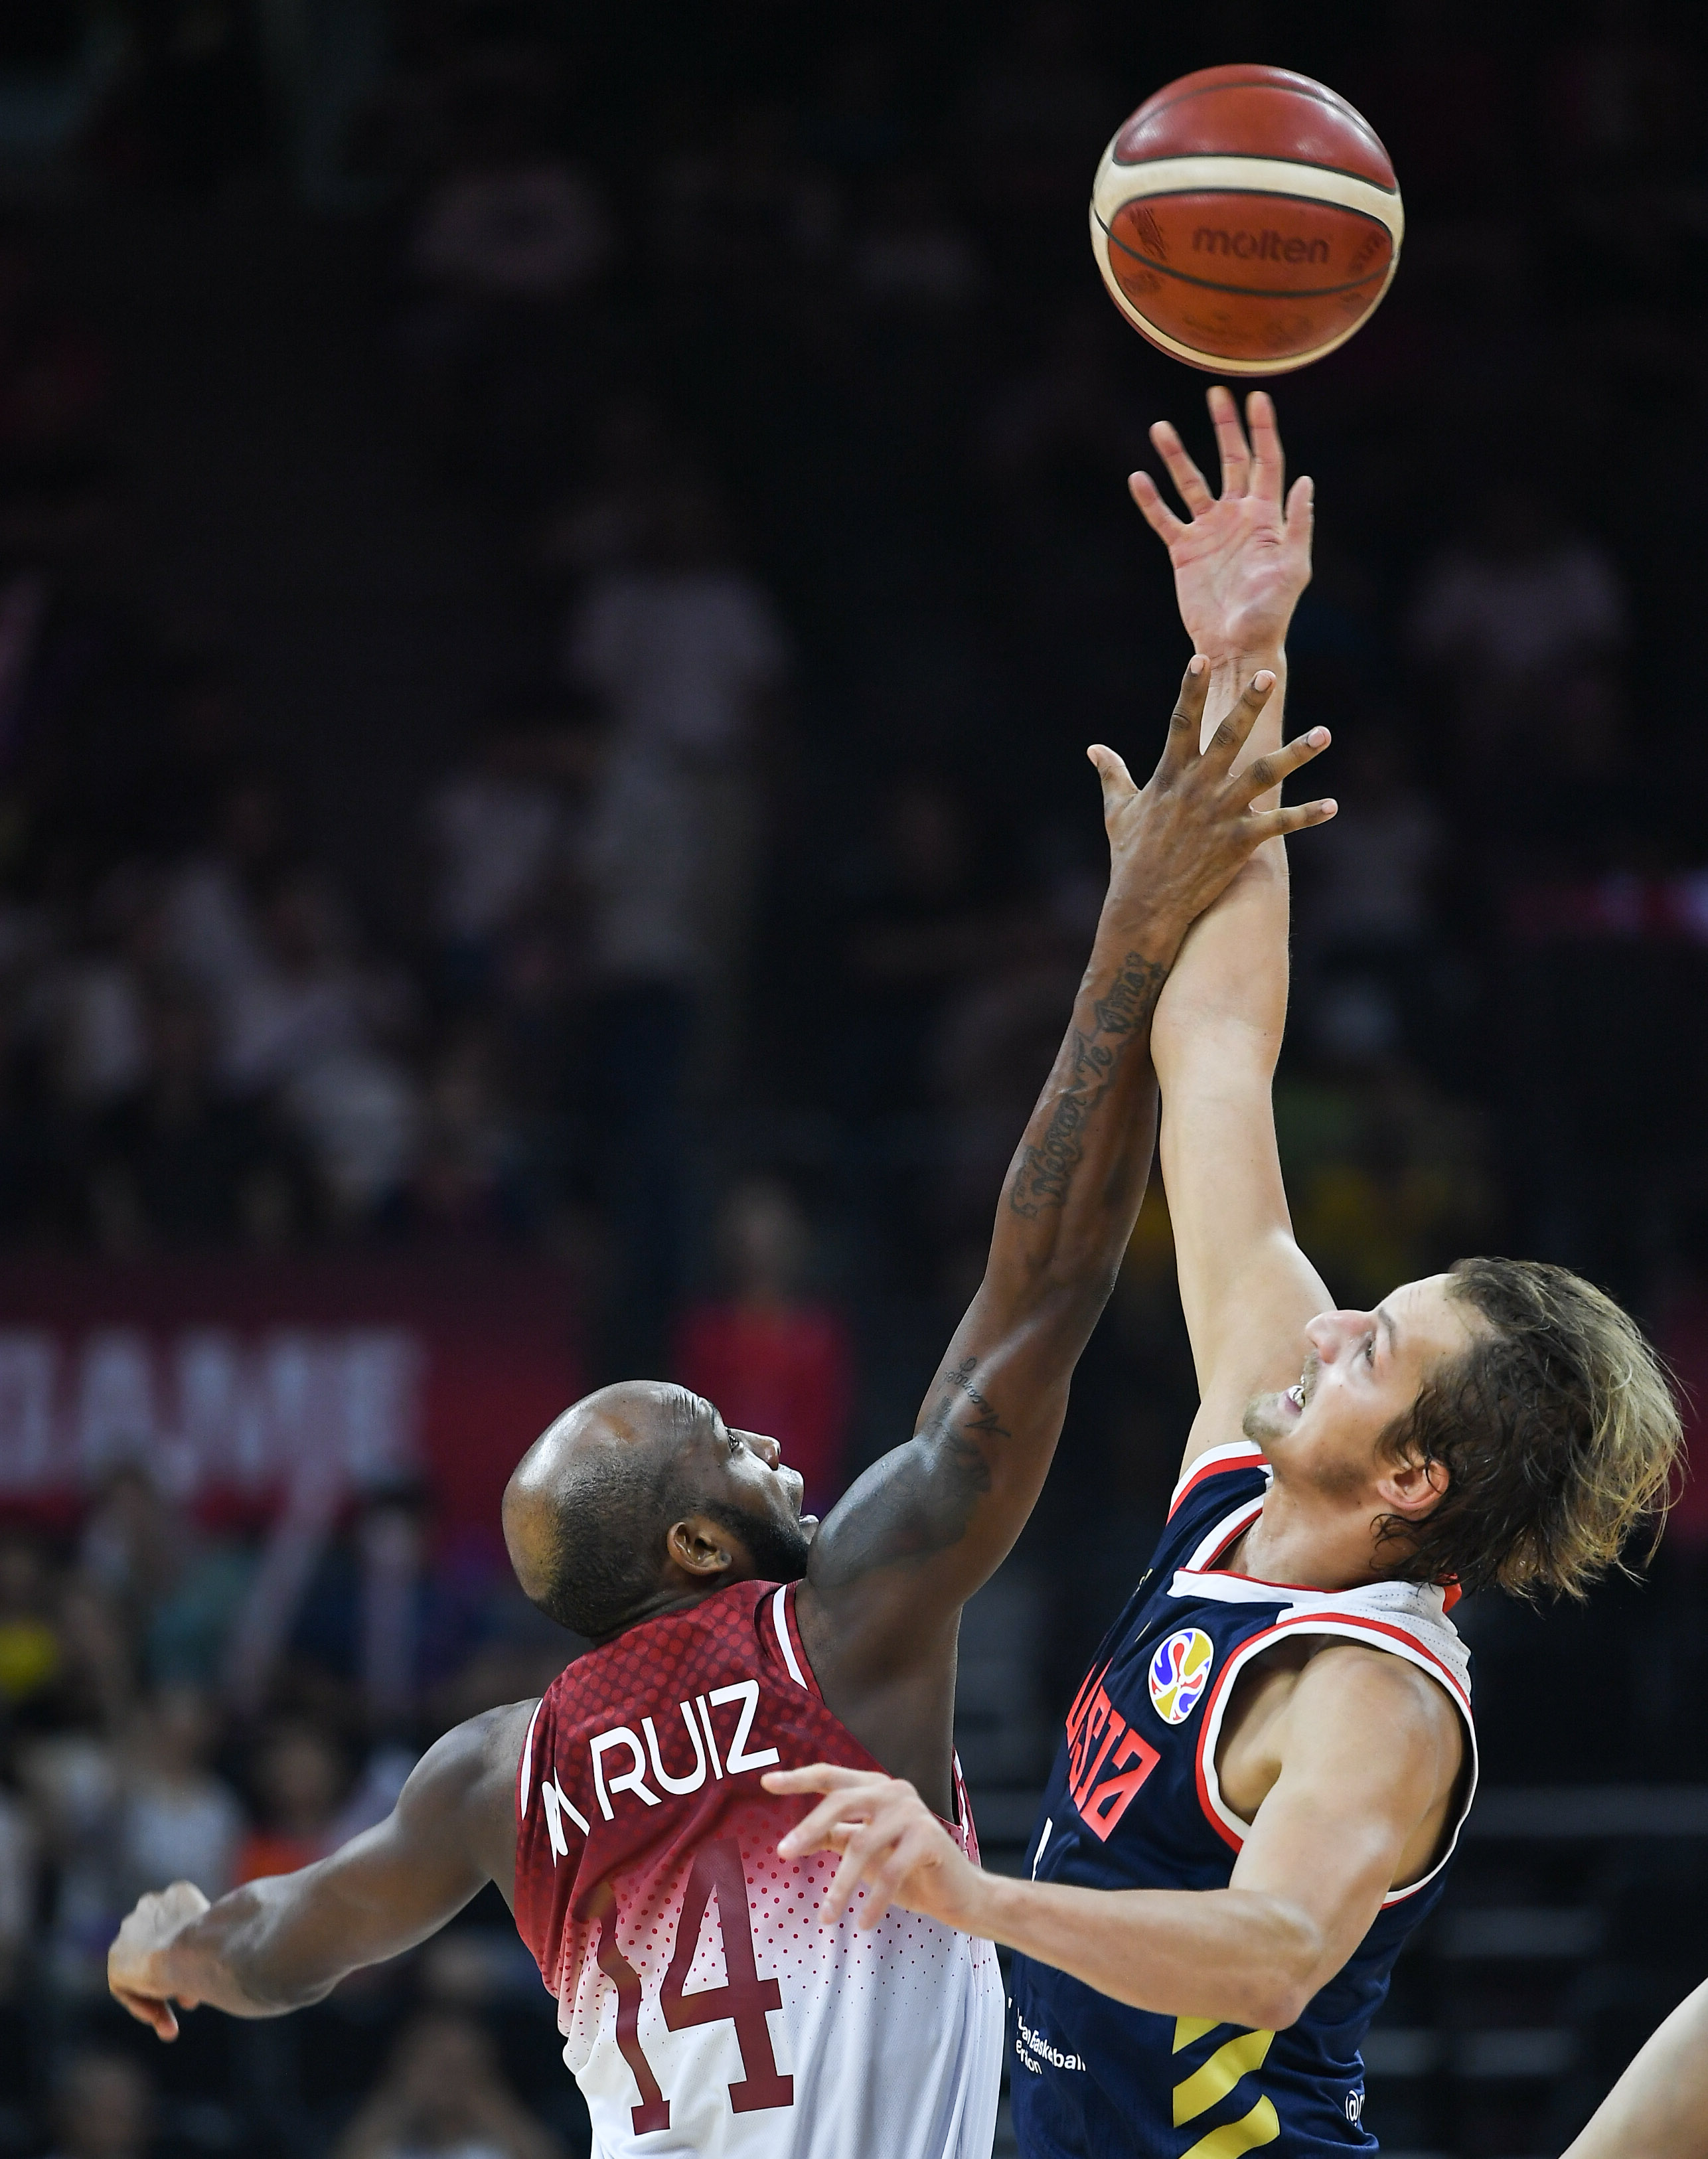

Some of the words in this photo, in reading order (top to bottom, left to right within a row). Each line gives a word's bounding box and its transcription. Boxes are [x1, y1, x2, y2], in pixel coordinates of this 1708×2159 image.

[1193, 226, 1328, 264] molten
[589, 1678, 781, 1822] RUIZ
[572, 1836, 795, 2136] 14
